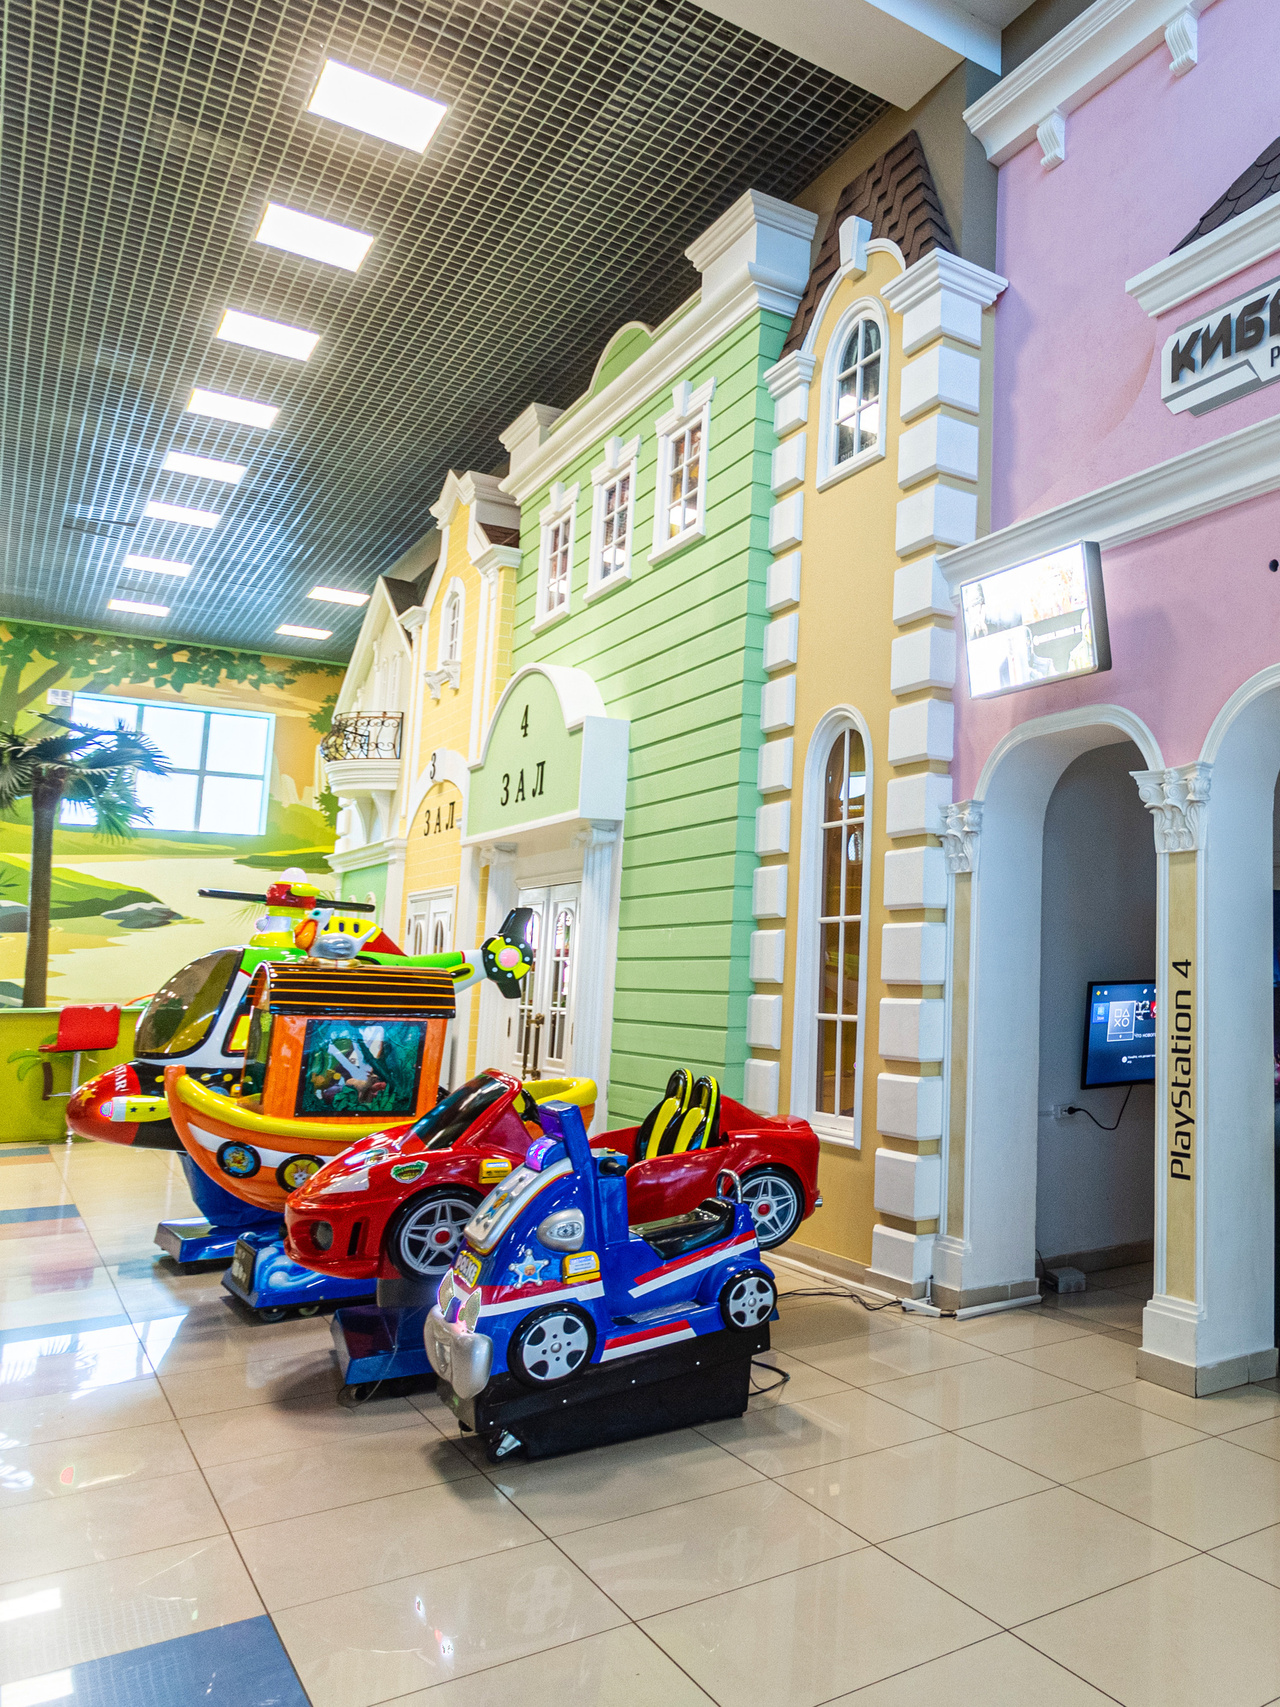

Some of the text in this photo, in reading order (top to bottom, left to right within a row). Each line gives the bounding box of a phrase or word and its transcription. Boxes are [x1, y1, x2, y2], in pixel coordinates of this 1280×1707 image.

[520, 704, 529, 738] 4
[430, 752, 437, 780] 3
[501, 760, 546, 806] ЗАЛ
[424, 801, 456, 837] ЗАЛ
[1170, 959, 1195, 1181] PlayStation 4
[454, 1253, 478, 1284] POLICE
